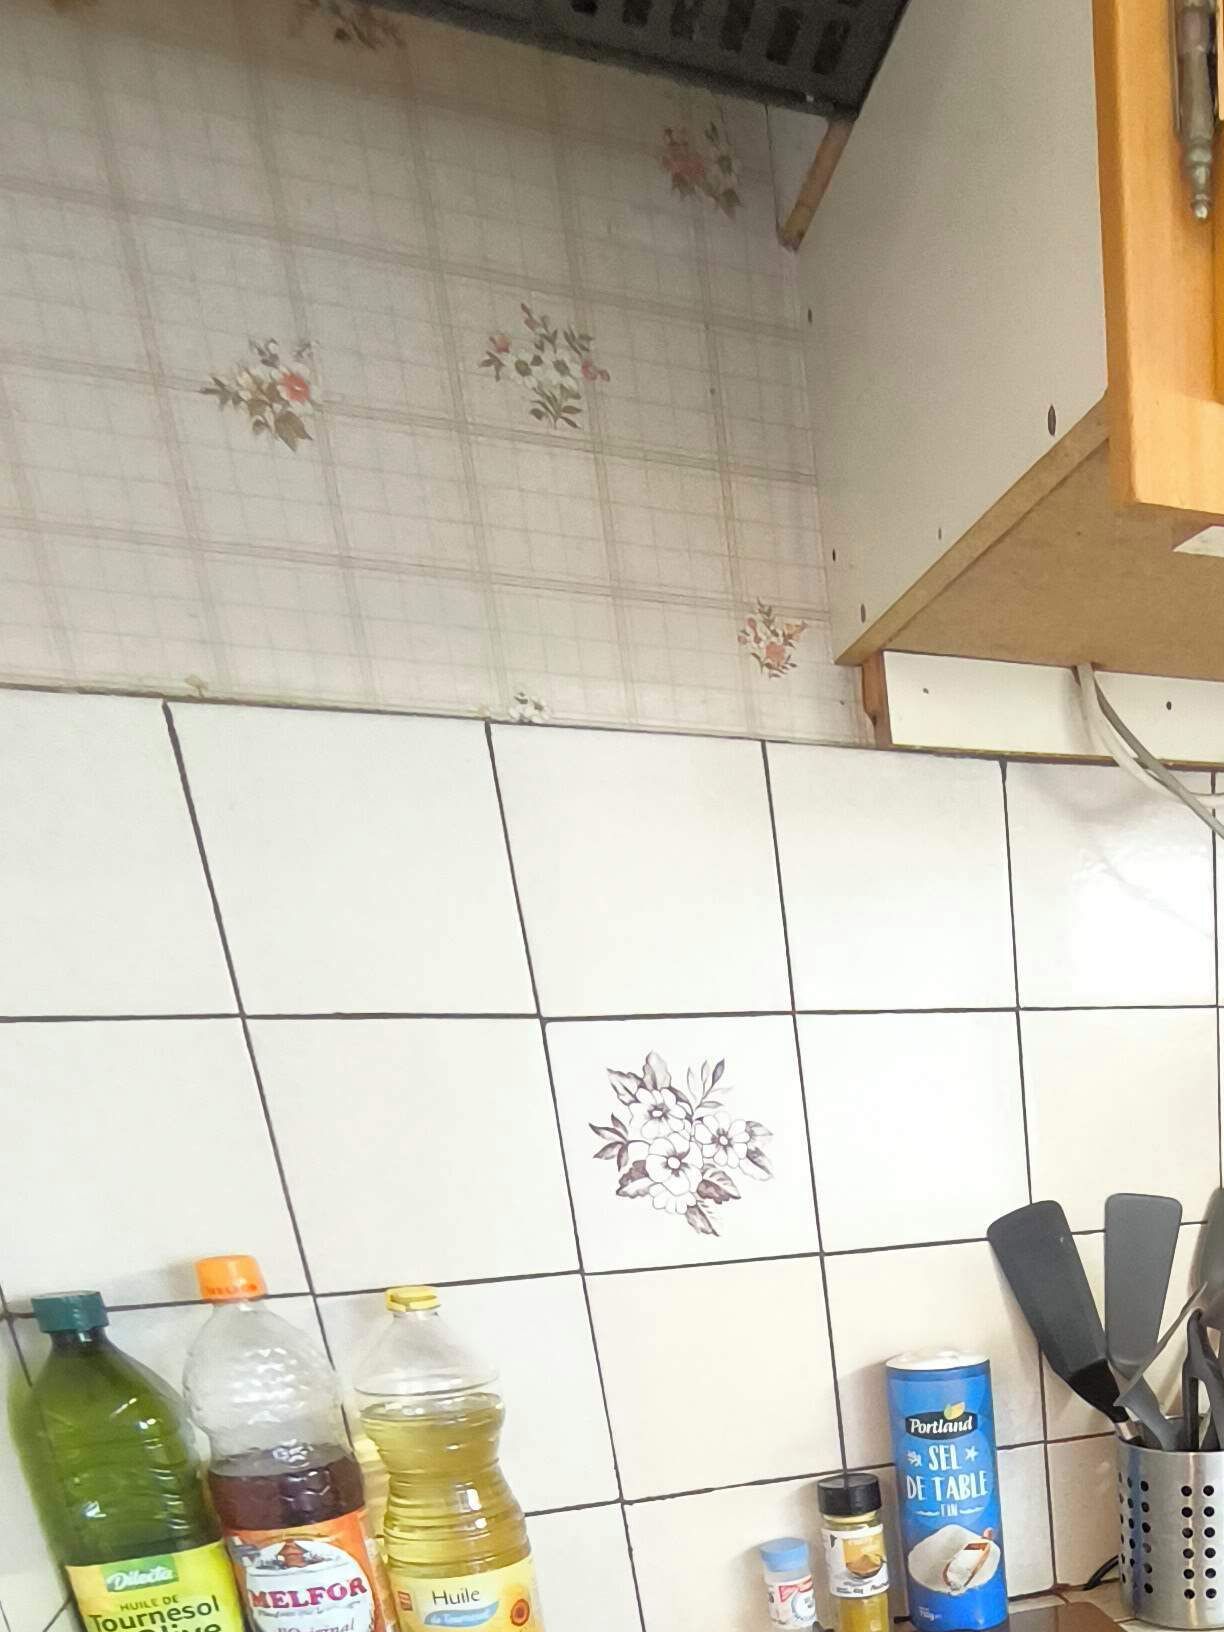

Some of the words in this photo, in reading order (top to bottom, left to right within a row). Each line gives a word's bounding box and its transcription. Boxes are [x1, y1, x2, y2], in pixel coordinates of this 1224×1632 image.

[908, 1415, 973, 1435] Portland
[928, 1444, 962, 1472] SEL
[906, 1475, 927, 1501] DE
[931, 1470, 989, 1502] TABLE
[119, 1596, 161, 1613] HUILE
[162, 1593, 180, 1607] DE
[247, 1576, 369, 1610] MELFOR
[431, 1586, 481, 1606] Huile
